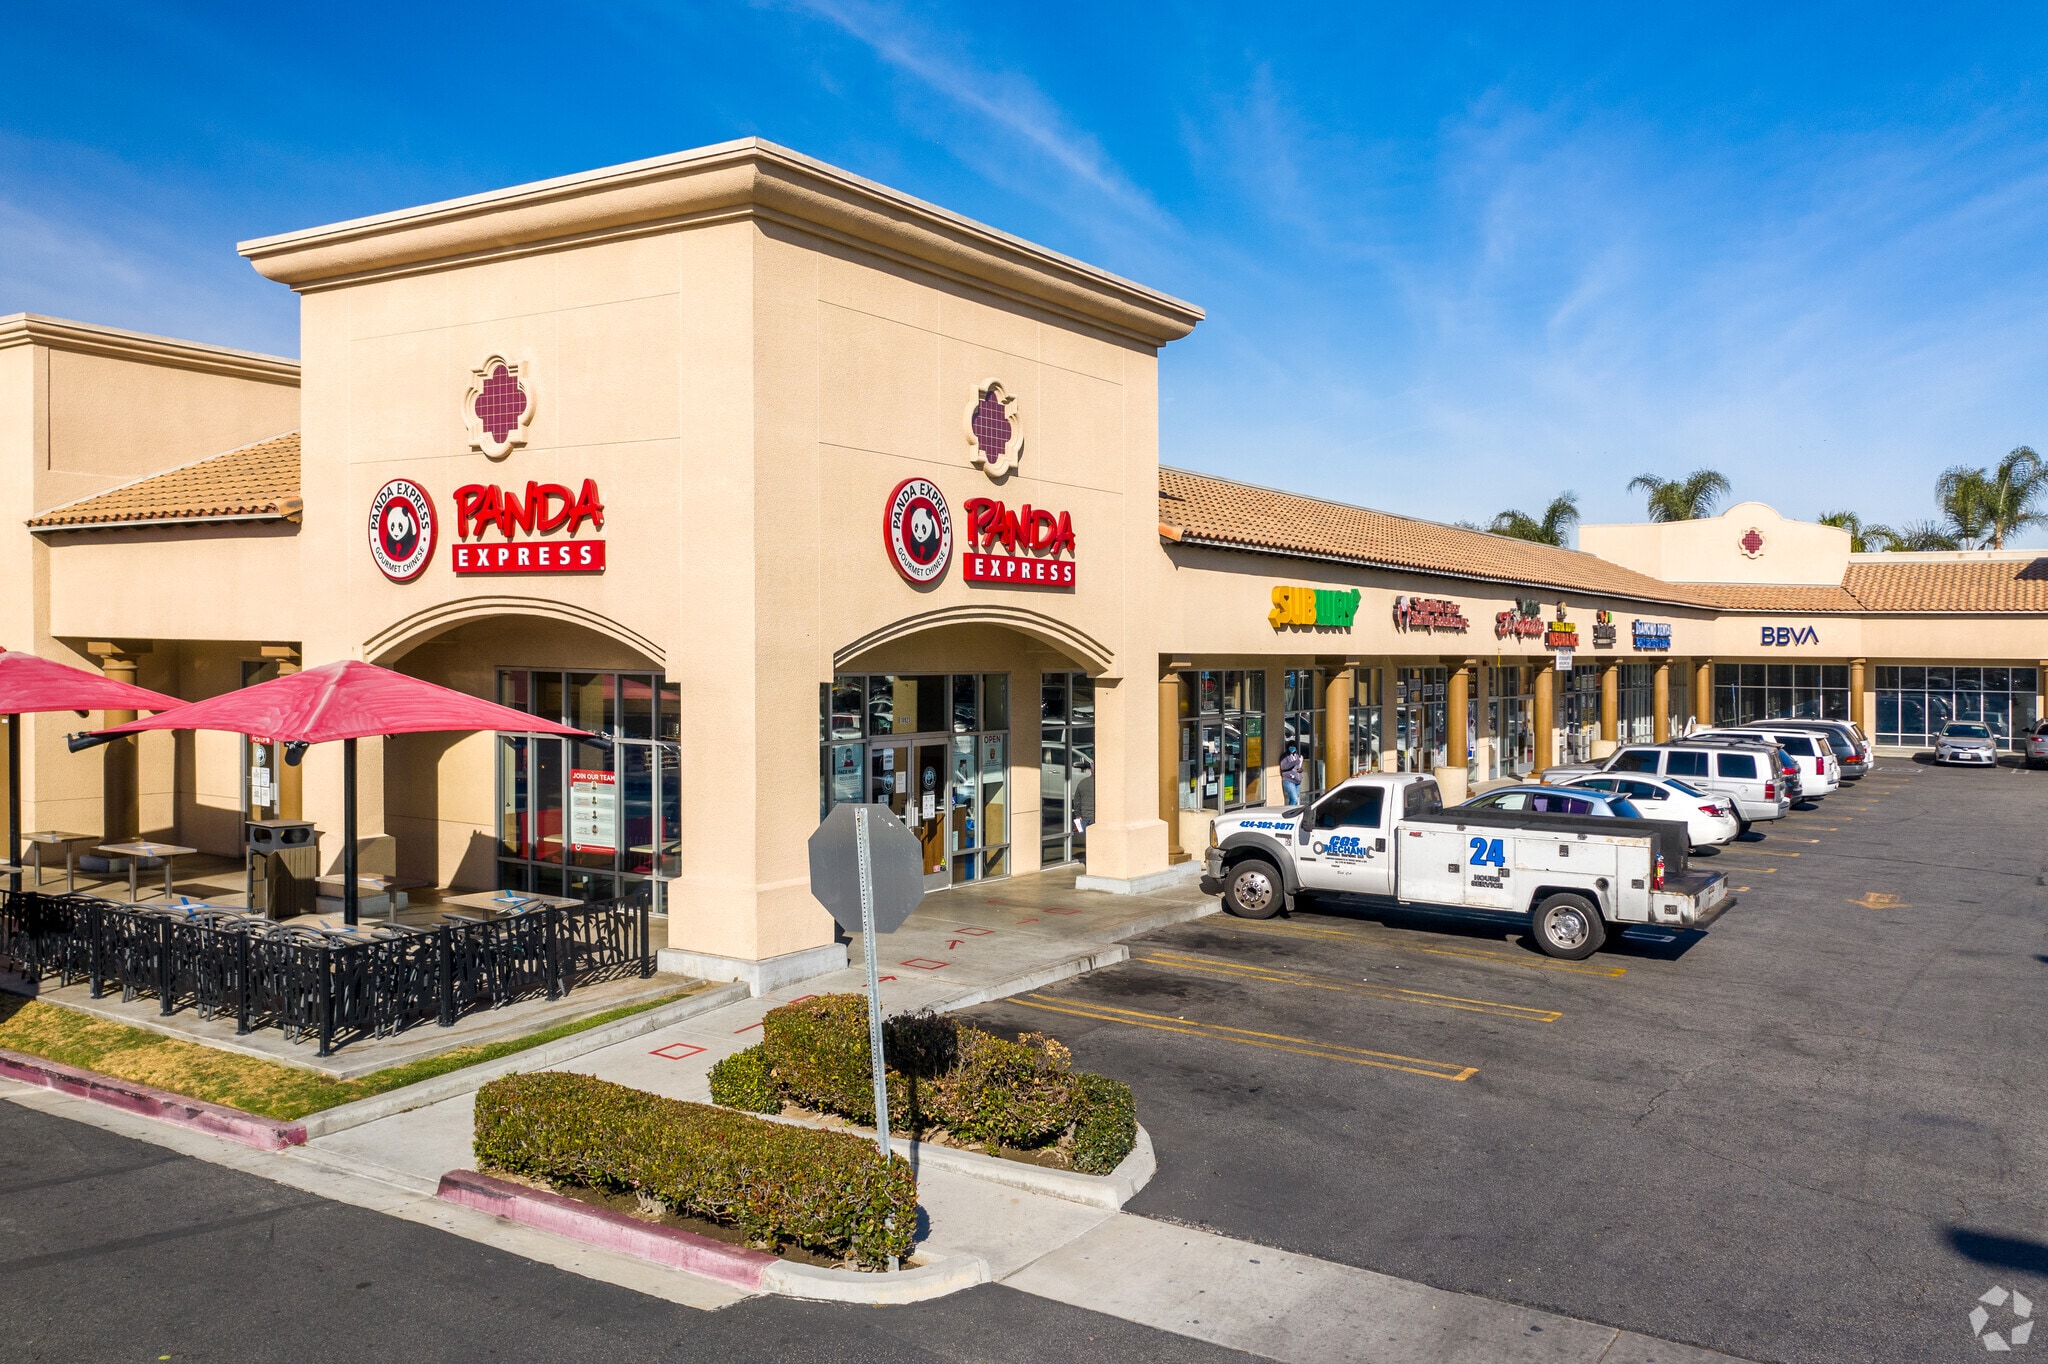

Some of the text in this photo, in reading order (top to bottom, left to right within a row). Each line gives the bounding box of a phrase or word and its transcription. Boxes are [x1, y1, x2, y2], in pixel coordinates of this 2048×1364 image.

[371, 483, 430, 530] PANDA EXPRESS
[453, 479, 604, 538] PANDA
[893, 483, 950, 534] PANDA EXPRESS
[964, 497, 1076, 554] PANDA
[375, 545, 425, 573] GOURMET CHINESE
[458, 545, 592, 567] EXPRESS
[897, 547, 945, 577] GOURMET CHINESE
[975, 558, 1072, 581] EXPRESS
[1268, 586, 1361, 627] SUBWAY
[1549, 632, 1579, 646] INSURANCE
[1761, 625, 1819, 646] BBVA
[984, 735, 1000, 744] OPEN
[587, 773, 599, 781] OUR
[1470, 837, 1505, 867] 24
[1471, 880, 1504, 889] SERVICE
[1474, 874, 1501, 882] HOURS
